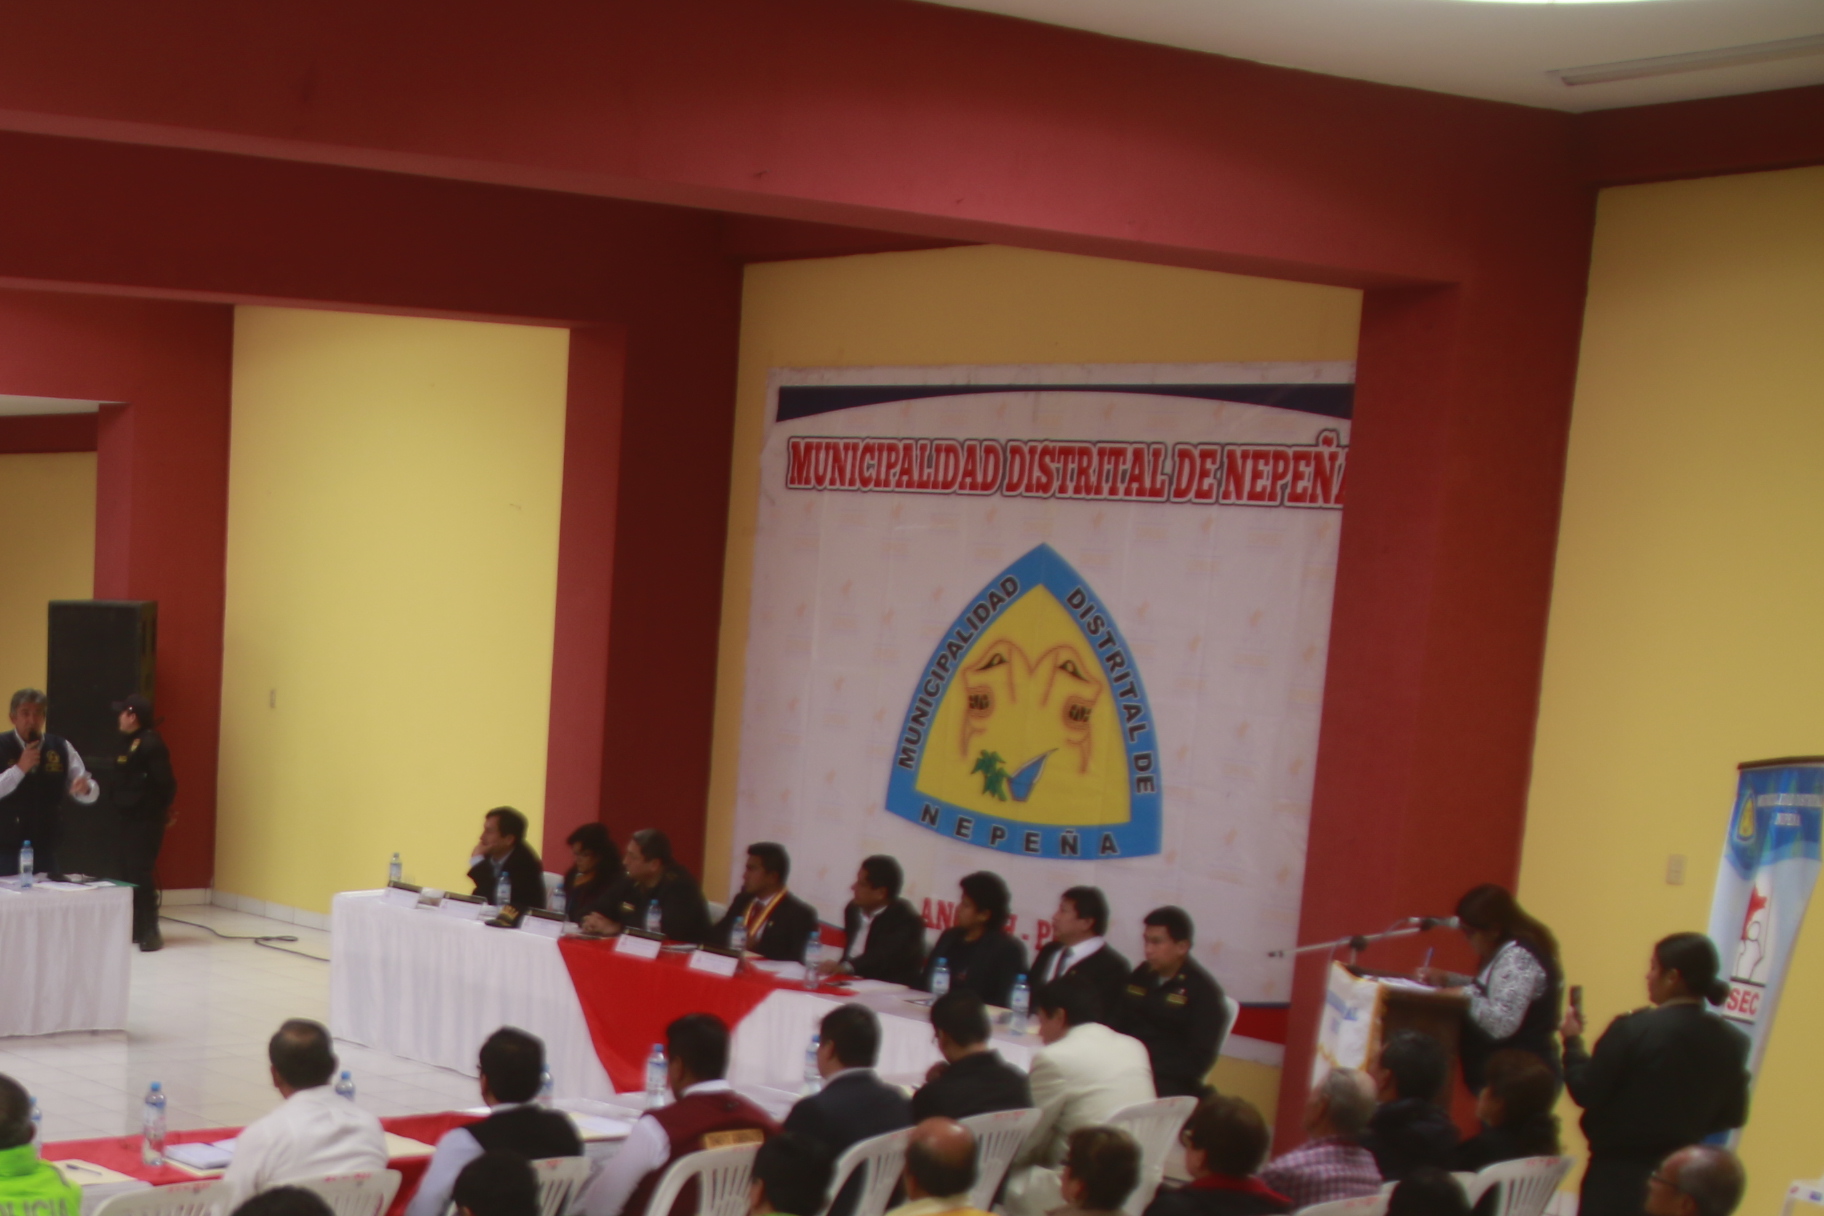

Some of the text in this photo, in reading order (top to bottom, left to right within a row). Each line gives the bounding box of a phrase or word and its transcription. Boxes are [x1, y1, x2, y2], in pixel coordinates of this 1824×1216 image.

[788, 439, 1002, 494] MUNICIPALIDAD
[1004, 444, 1168, 499] DISTRITAL
[1172, 447, 1222, 502] DE
[897, 575, 1157, 794] MUNICIPALIDAD DISTRITAL DE
[920, 803, 1119, 856] NEPEÑA
